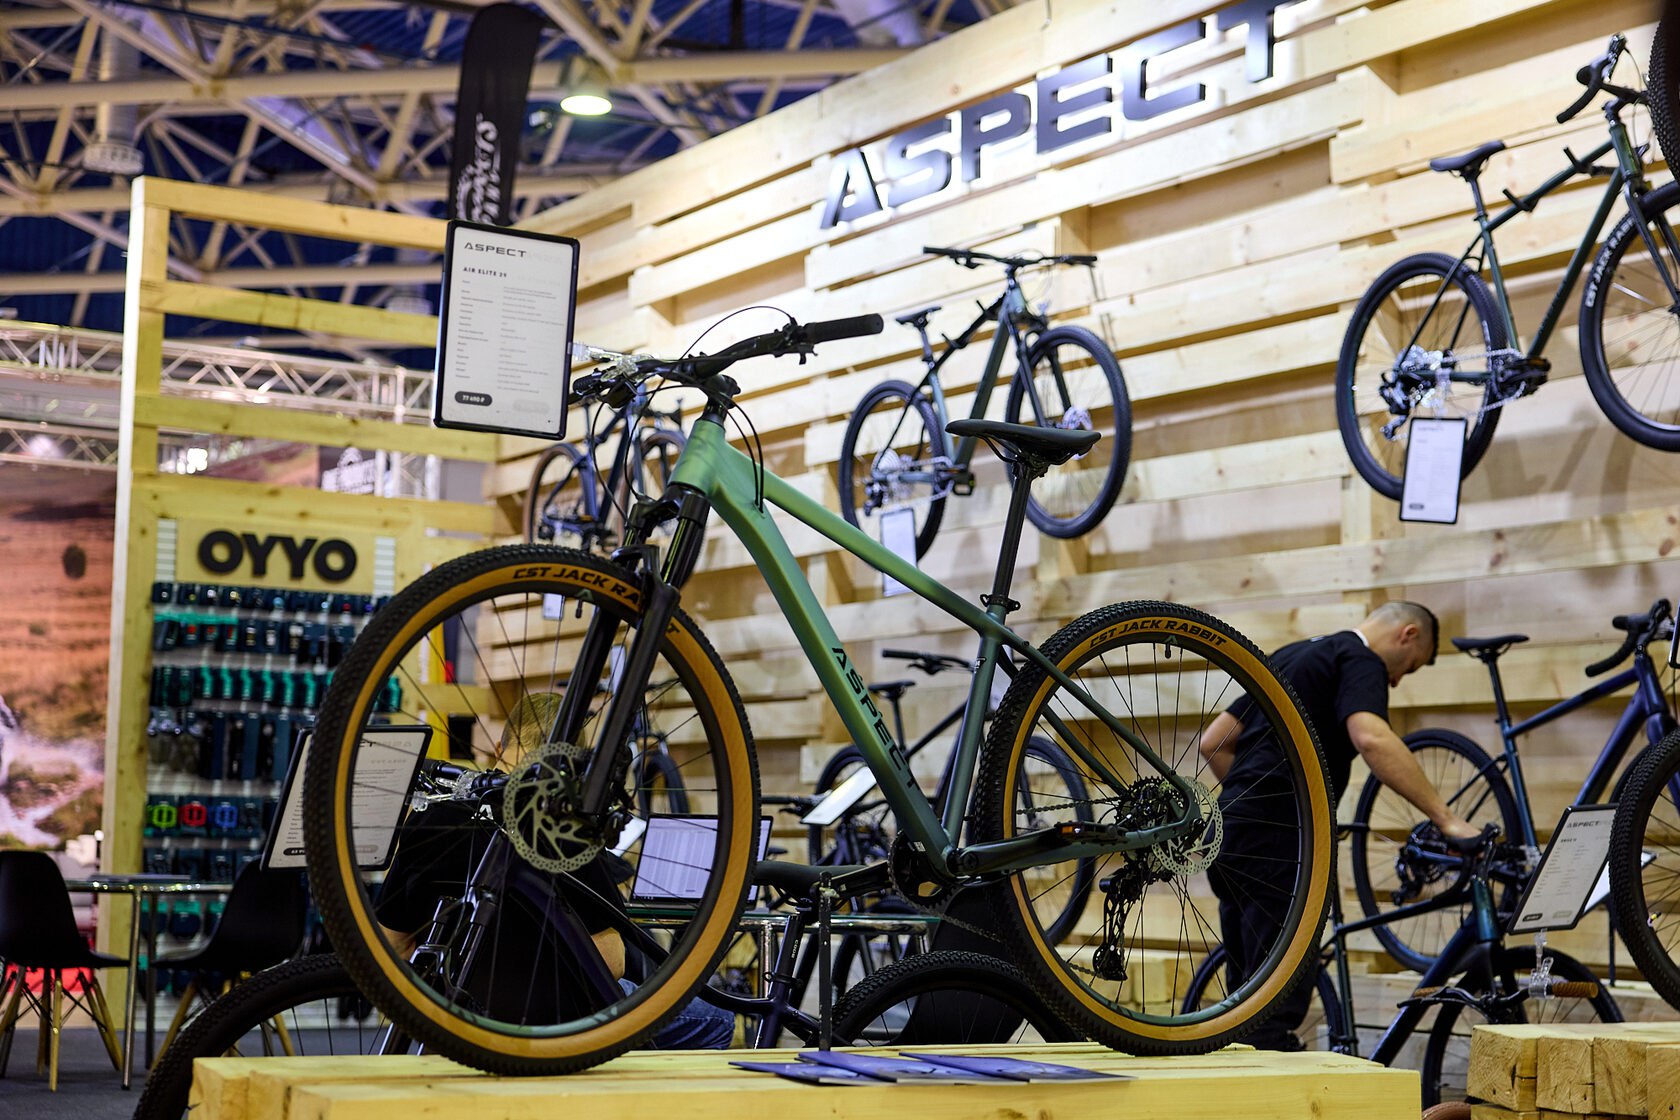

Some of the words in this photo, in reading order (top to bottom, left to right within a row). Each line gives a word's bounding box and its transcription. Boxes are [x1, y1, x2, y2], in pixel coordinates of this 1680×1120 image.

[820, 0, 1306, 230] ASPECT
[464, 242, 527, 257] ASPECT
[478, 268, 497, 276] ELITE
[198, 529, 357, 583] OYYO
[512, 567, 552, 580] CST
[552, 567, 609, 589] JACK
[1089, 627, 1118, 649] CST
[1118, 619, 1162, 635] JACK
[1164, 620, 1228, 647] RABBIT
[832, 647, 921, 791] ASPECT
